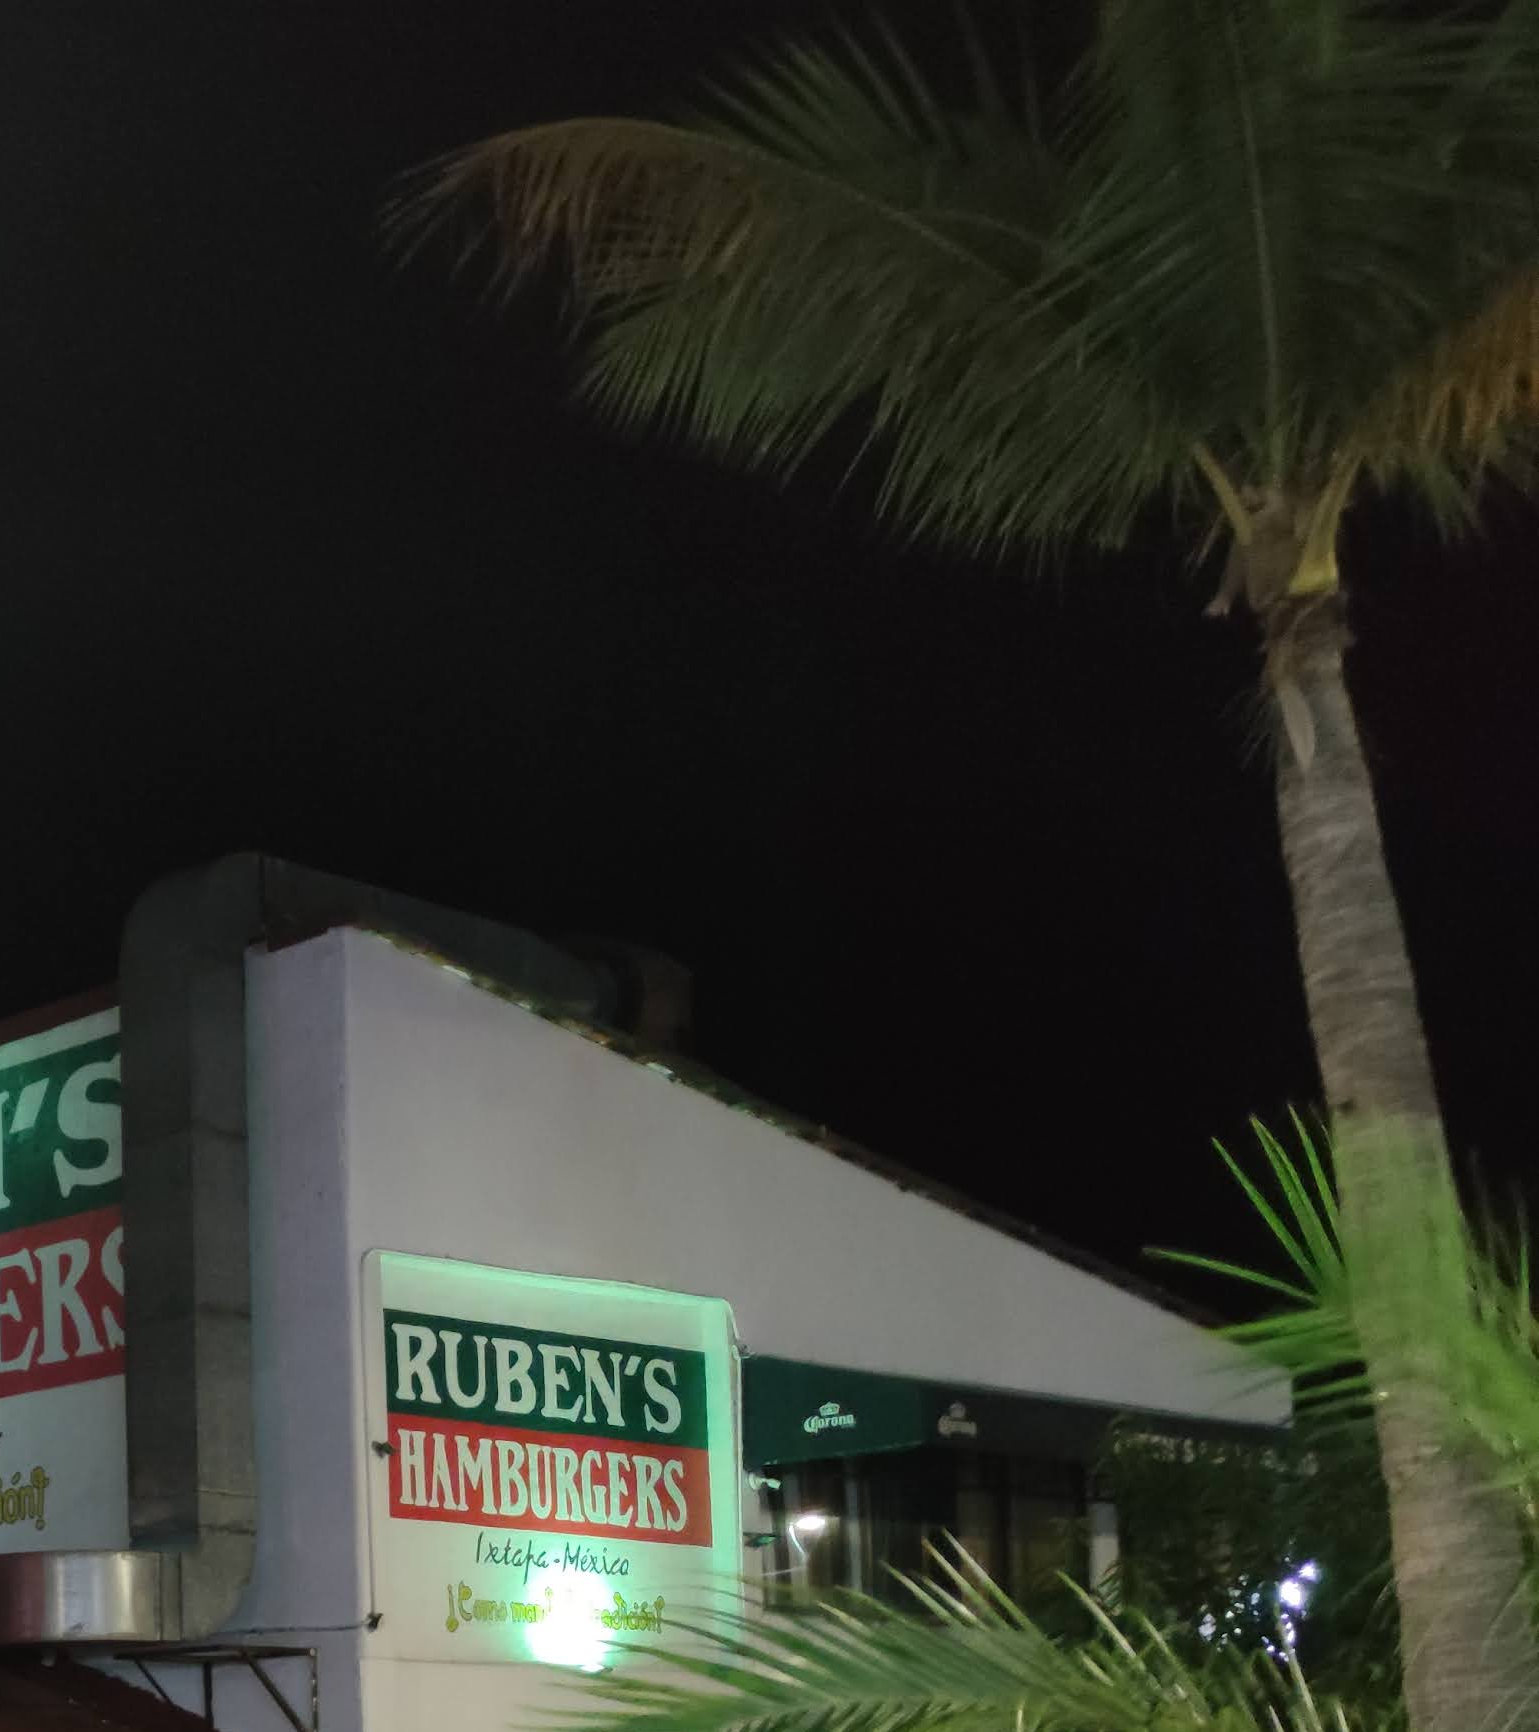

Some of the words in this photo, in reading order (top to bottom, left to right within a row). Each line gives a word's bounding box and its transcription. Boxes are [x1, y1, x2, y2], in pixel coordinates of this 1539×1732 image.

[392, 1323, 682, 1434] RUBEN'S
[803, 1414, 855, 1433] Corona
[398, 1429, 687, 1532] HAMBURGERS
